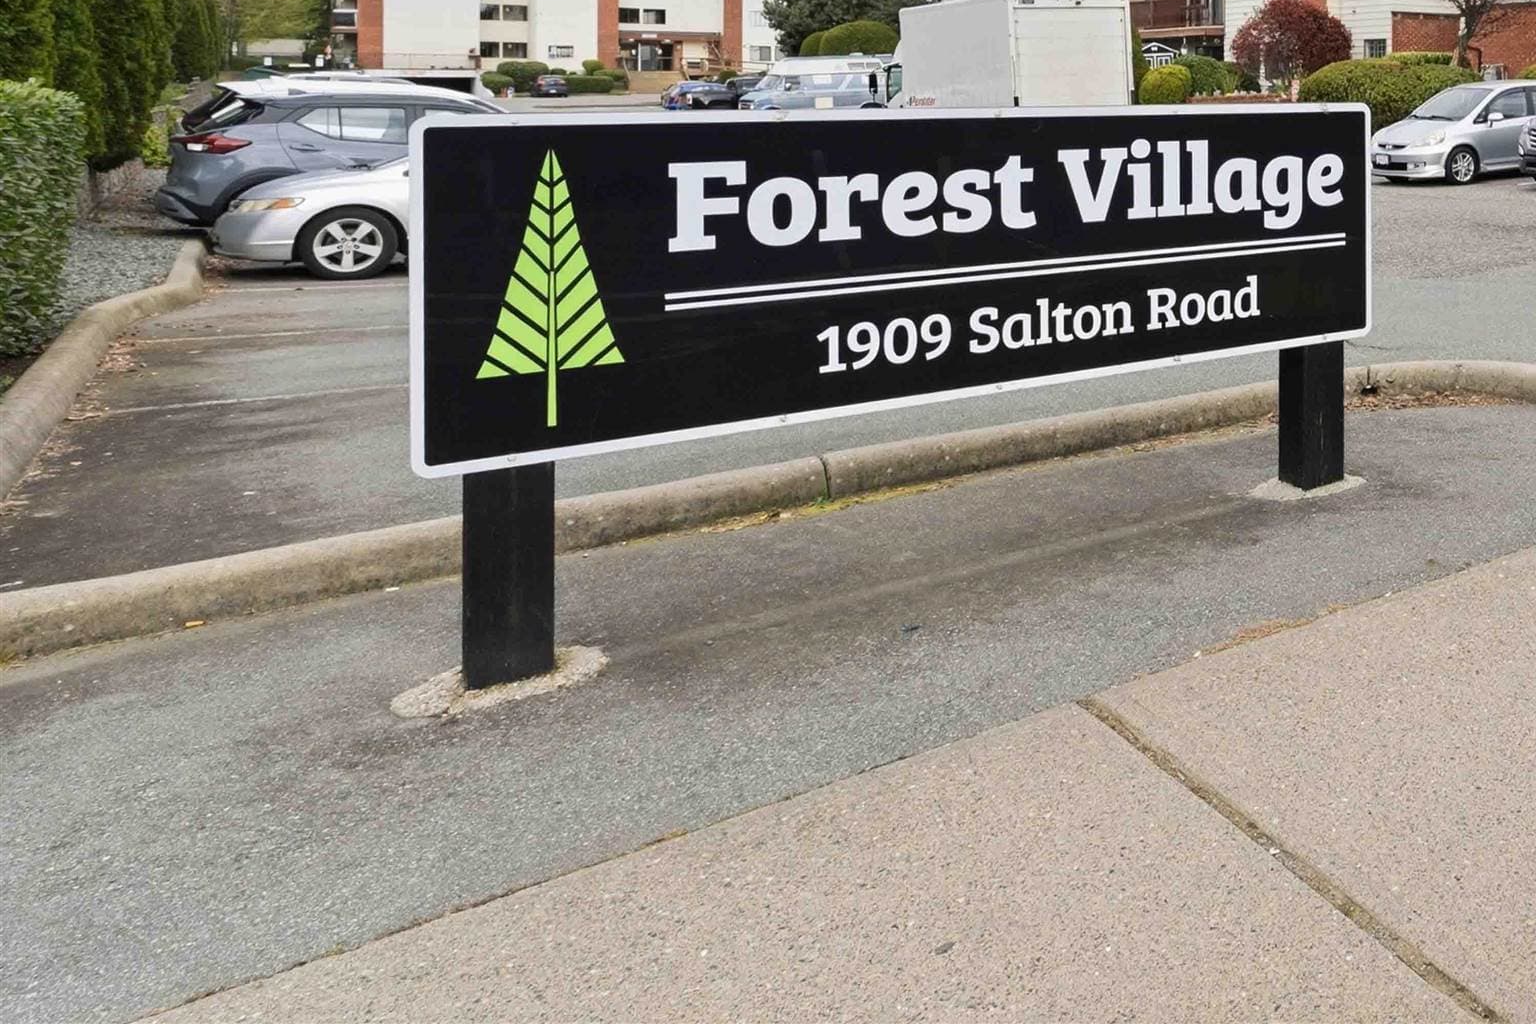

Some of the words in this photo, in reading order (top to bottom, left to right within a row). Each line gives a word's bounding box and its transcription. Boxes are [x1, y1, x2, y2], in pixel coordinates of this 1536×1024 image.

[668, 155, 1036, 253] Forest
[1057, 138, 1344, 230] Village
[816, 313, 952, 374] 1909
[969, 297, 1135, 354] Salton
[1147, 275, 1261, 331] Road
